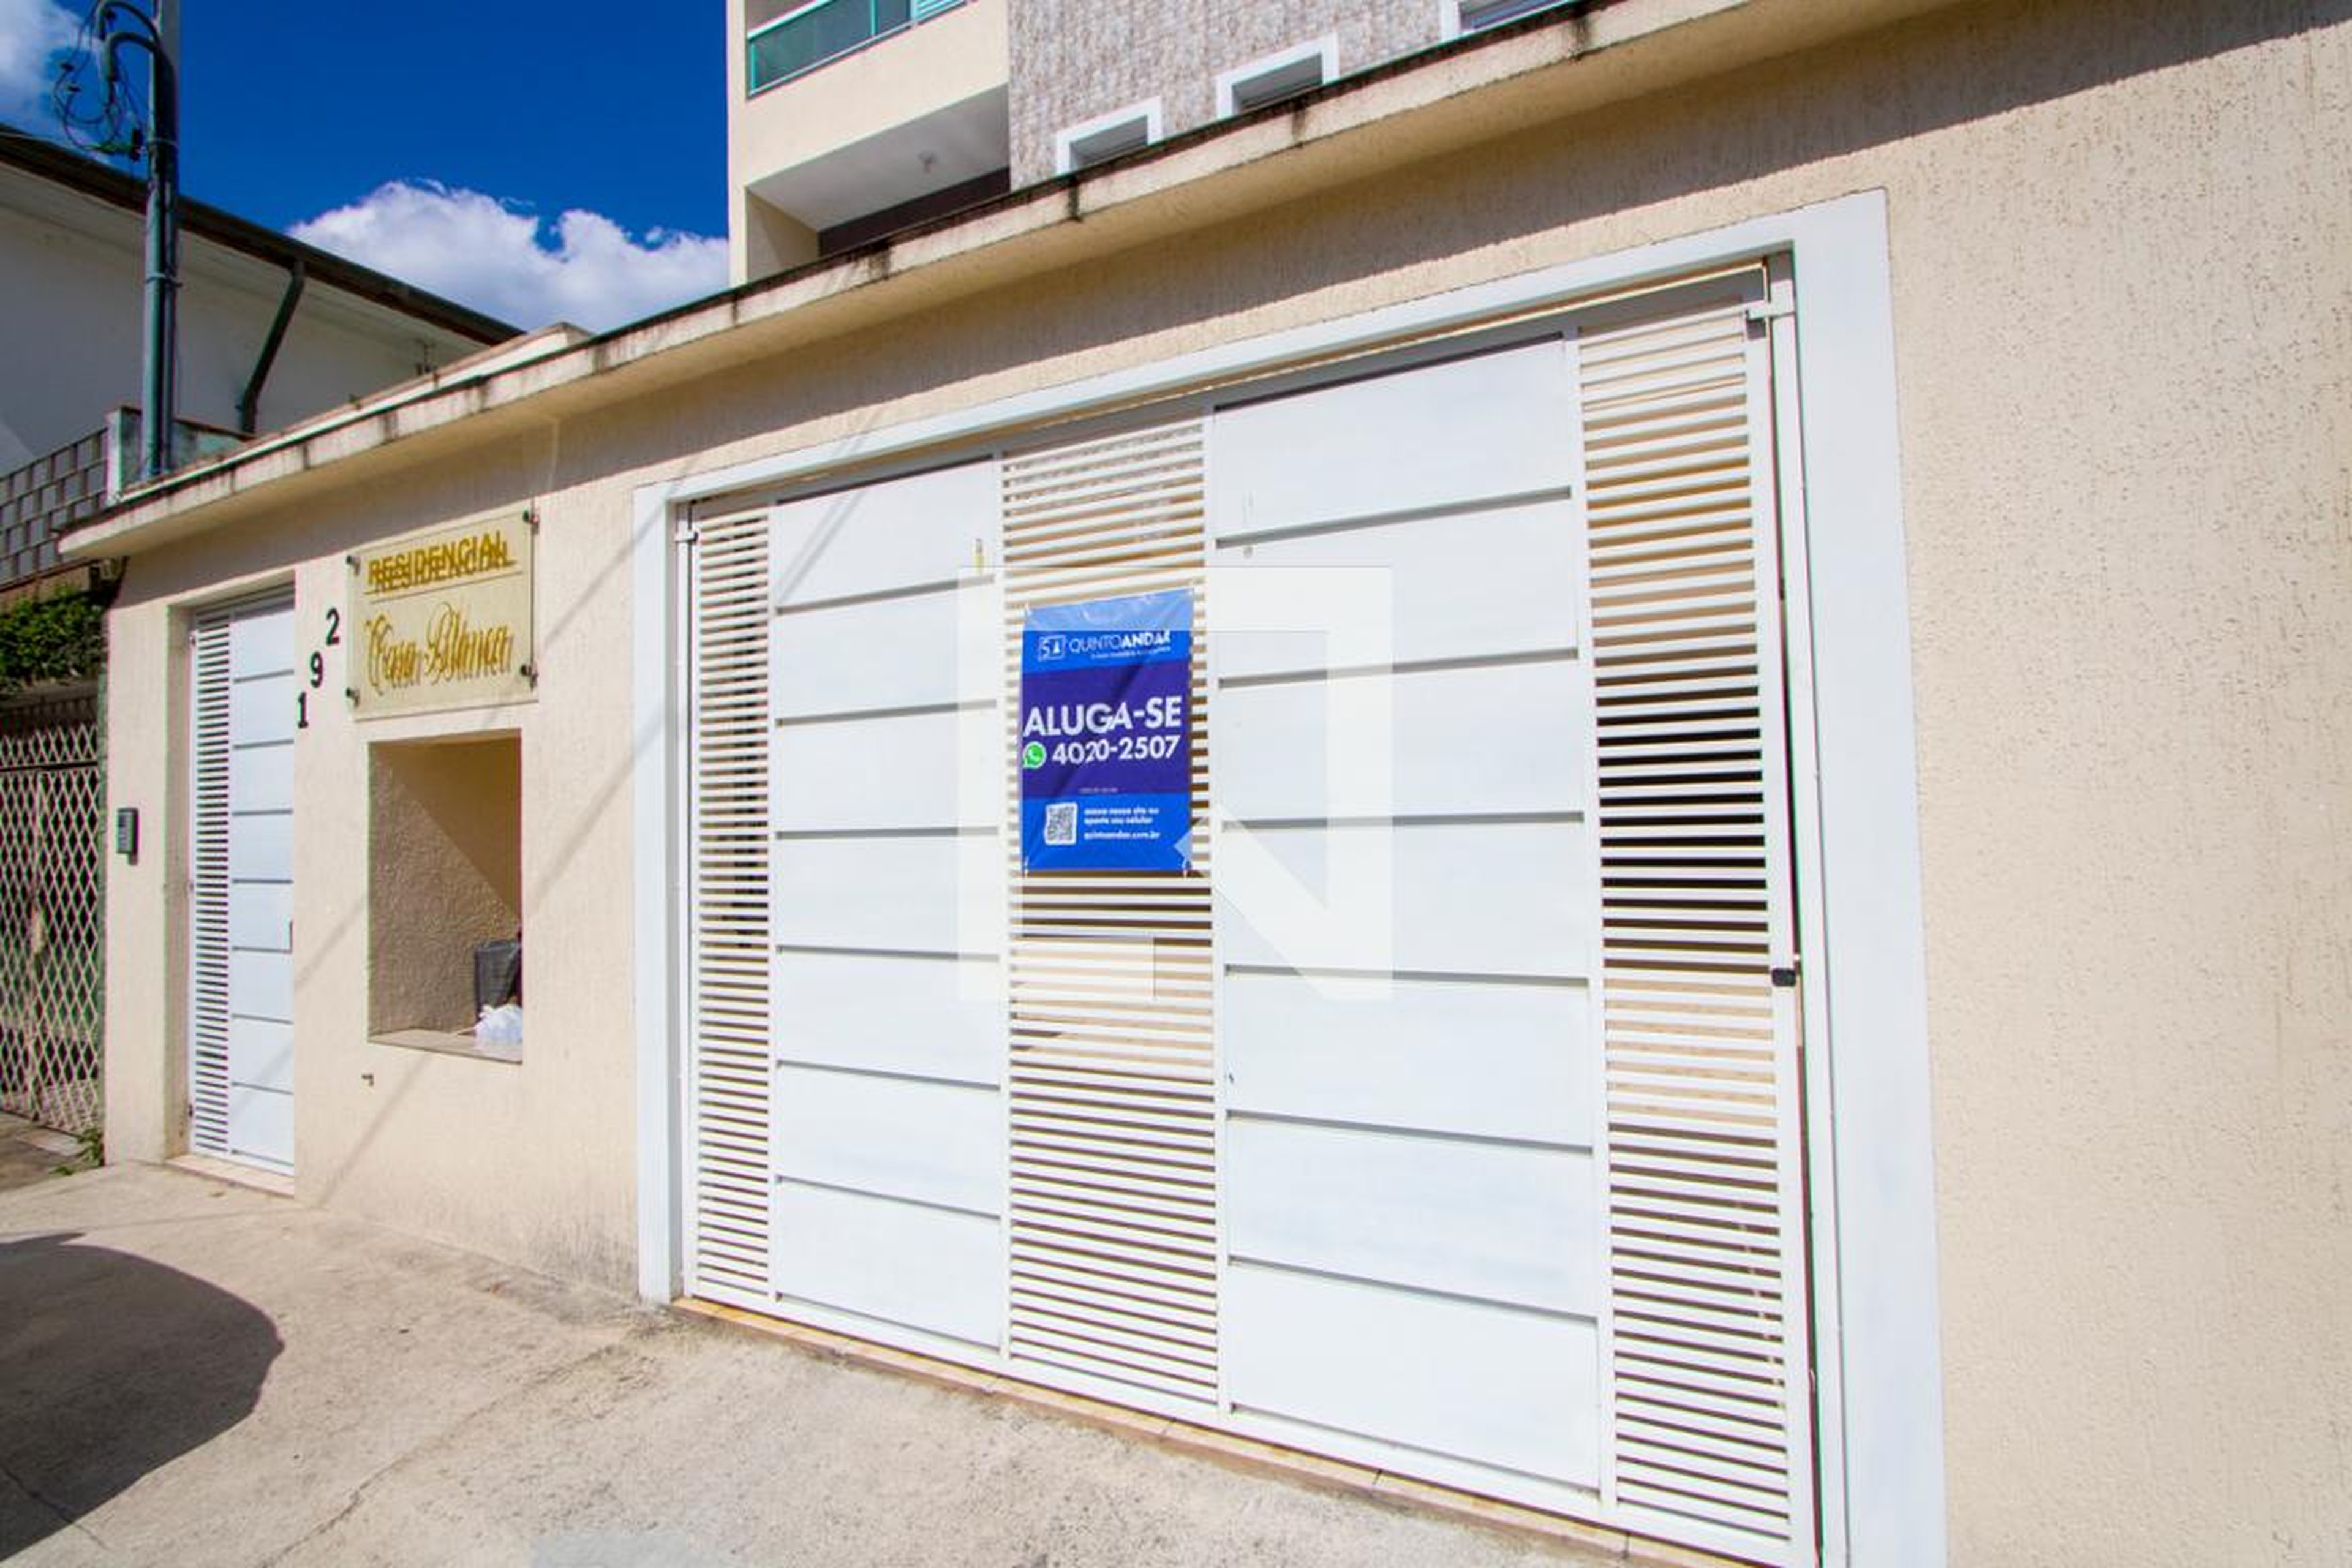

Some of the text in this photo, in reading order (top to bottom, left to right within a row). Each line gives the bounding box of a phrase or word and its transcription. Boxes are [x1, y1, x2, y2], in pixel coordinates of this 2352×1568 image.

[369, 530, 507, 592] RESIDENCIAL
[1023, 695, 1182, 737] ALUGA-SE
[1052, 735, 1181, 766] 4020-2507
